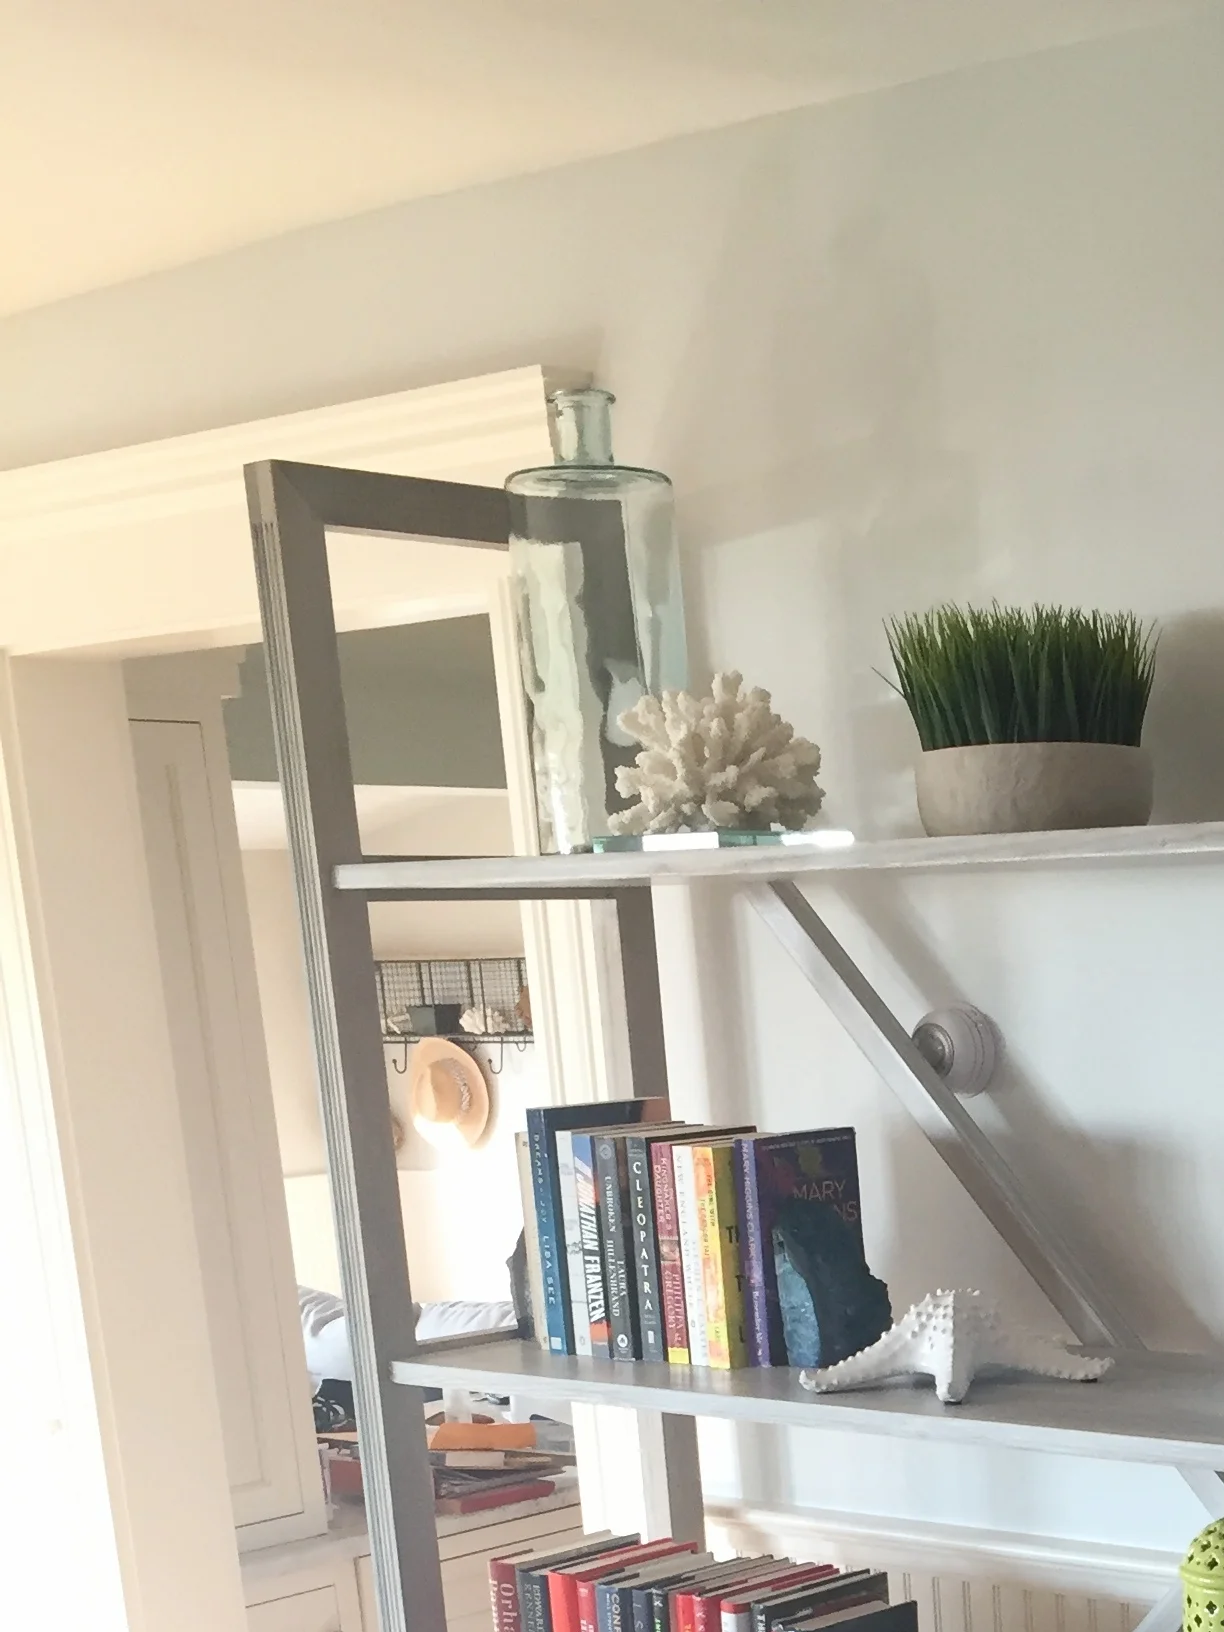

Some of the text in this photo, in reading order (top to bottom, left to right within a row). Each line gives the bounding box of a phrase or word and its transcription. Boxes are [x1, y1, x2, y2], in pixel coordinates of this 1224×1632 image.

[742, 1142, 751, 1175] MARY
[605, 1176, 618, 1233] UNBROKEN
[653, 1165, 665, 1224] DAUGHTER
[744, 1176, 755, 1220] HIGGINS
[792, 1180, 847, 1201] MARY
[577, 1172, 606, 1323] JONATHAN FRANZEN
[632, 1160, 653, 1312] CLEOPATRA
[542, 1234, 556, 1306] LISA SEE
[606, 1240, 621, 1318] HILLENBRAND
[618, 1259, 628, 1297] LAURA
[665, 1270, 677, 1330] GREGORY
